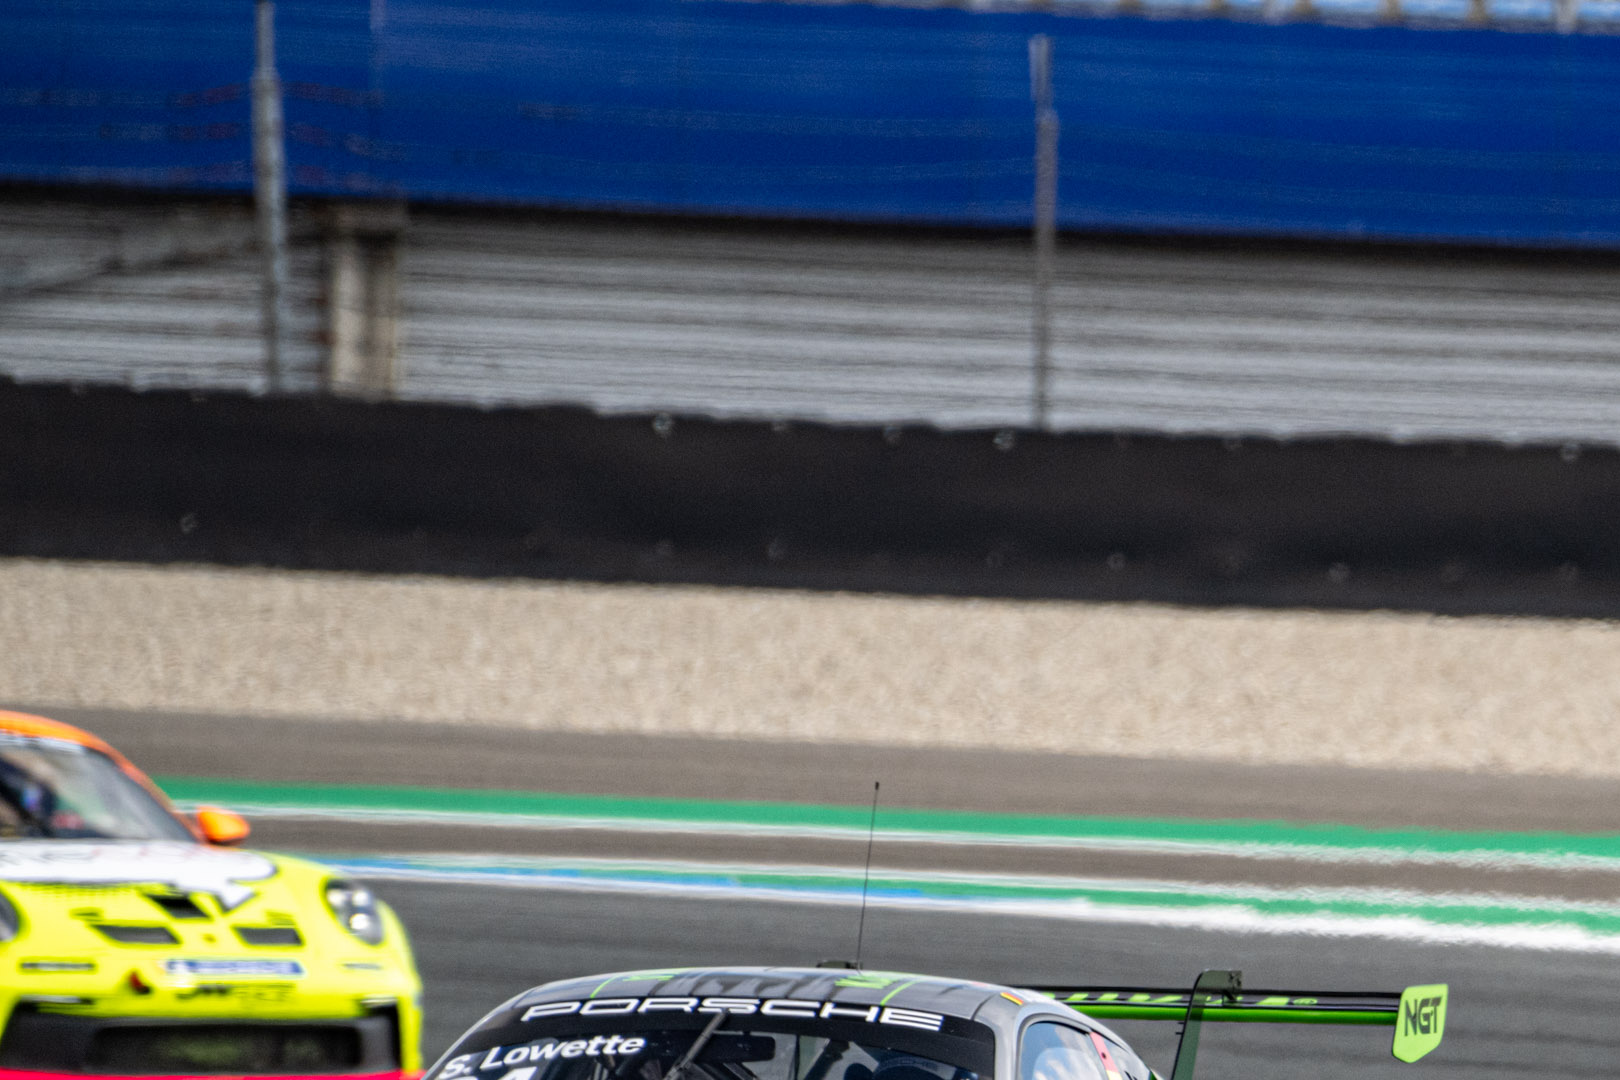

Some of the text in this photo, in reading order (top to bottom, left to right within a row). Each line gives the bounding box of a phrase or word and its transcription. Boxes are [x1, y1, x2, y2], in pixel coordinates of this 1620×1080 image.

[520, 998, 945, 1031] PORSCHE
[1403, 997, 1442, 1037] NGT
[439, 1035, 645, 1080] S. Lowette
